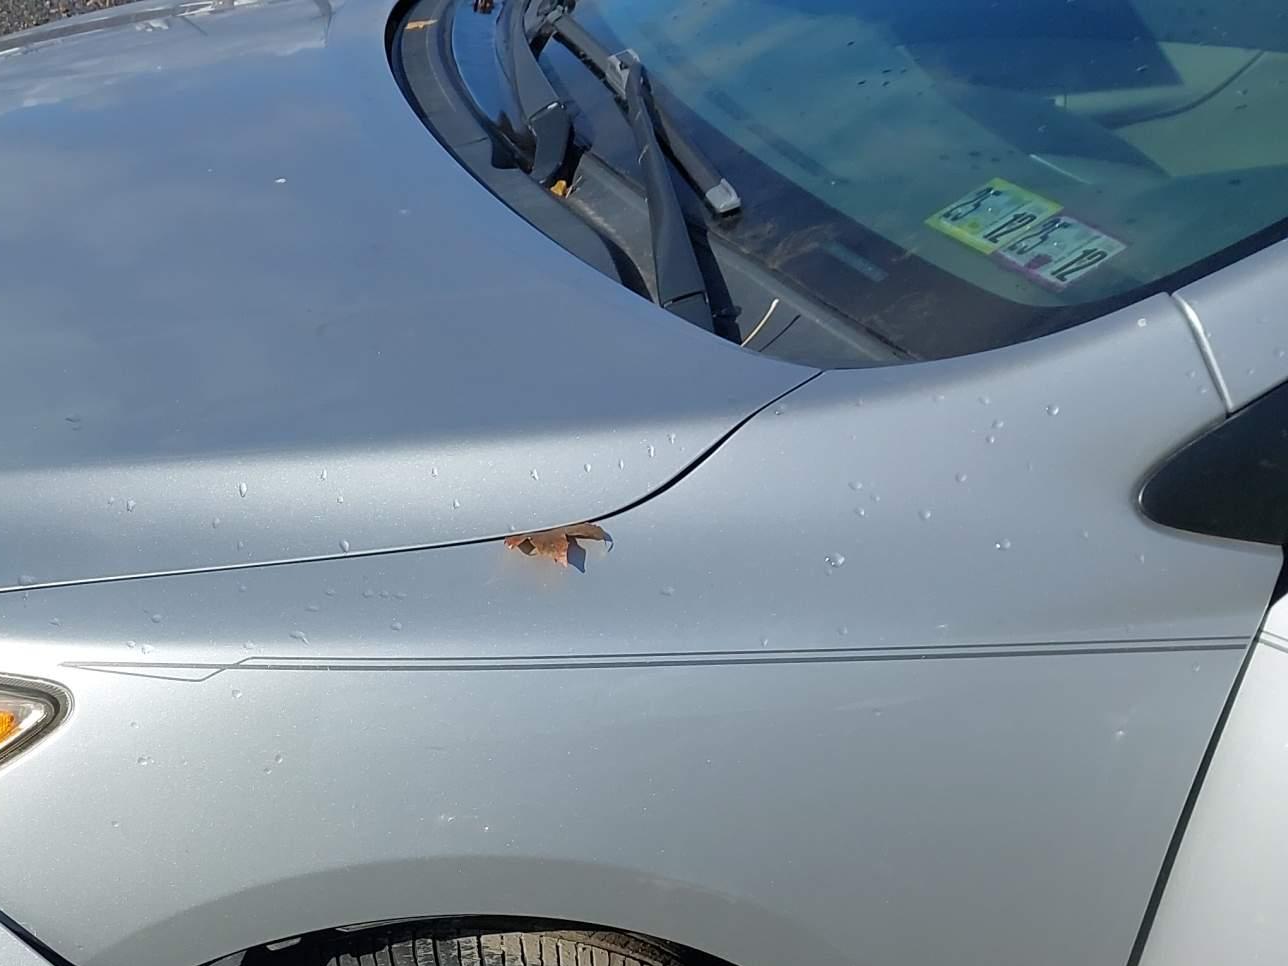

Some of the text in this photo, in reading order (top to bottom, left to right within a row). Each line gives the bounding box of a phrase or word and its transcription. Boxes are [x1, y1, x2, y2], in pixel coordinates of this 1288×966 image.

[942, 187, 1038, 243] 25 12
[1009, 218, 1109, 282] 25 12
